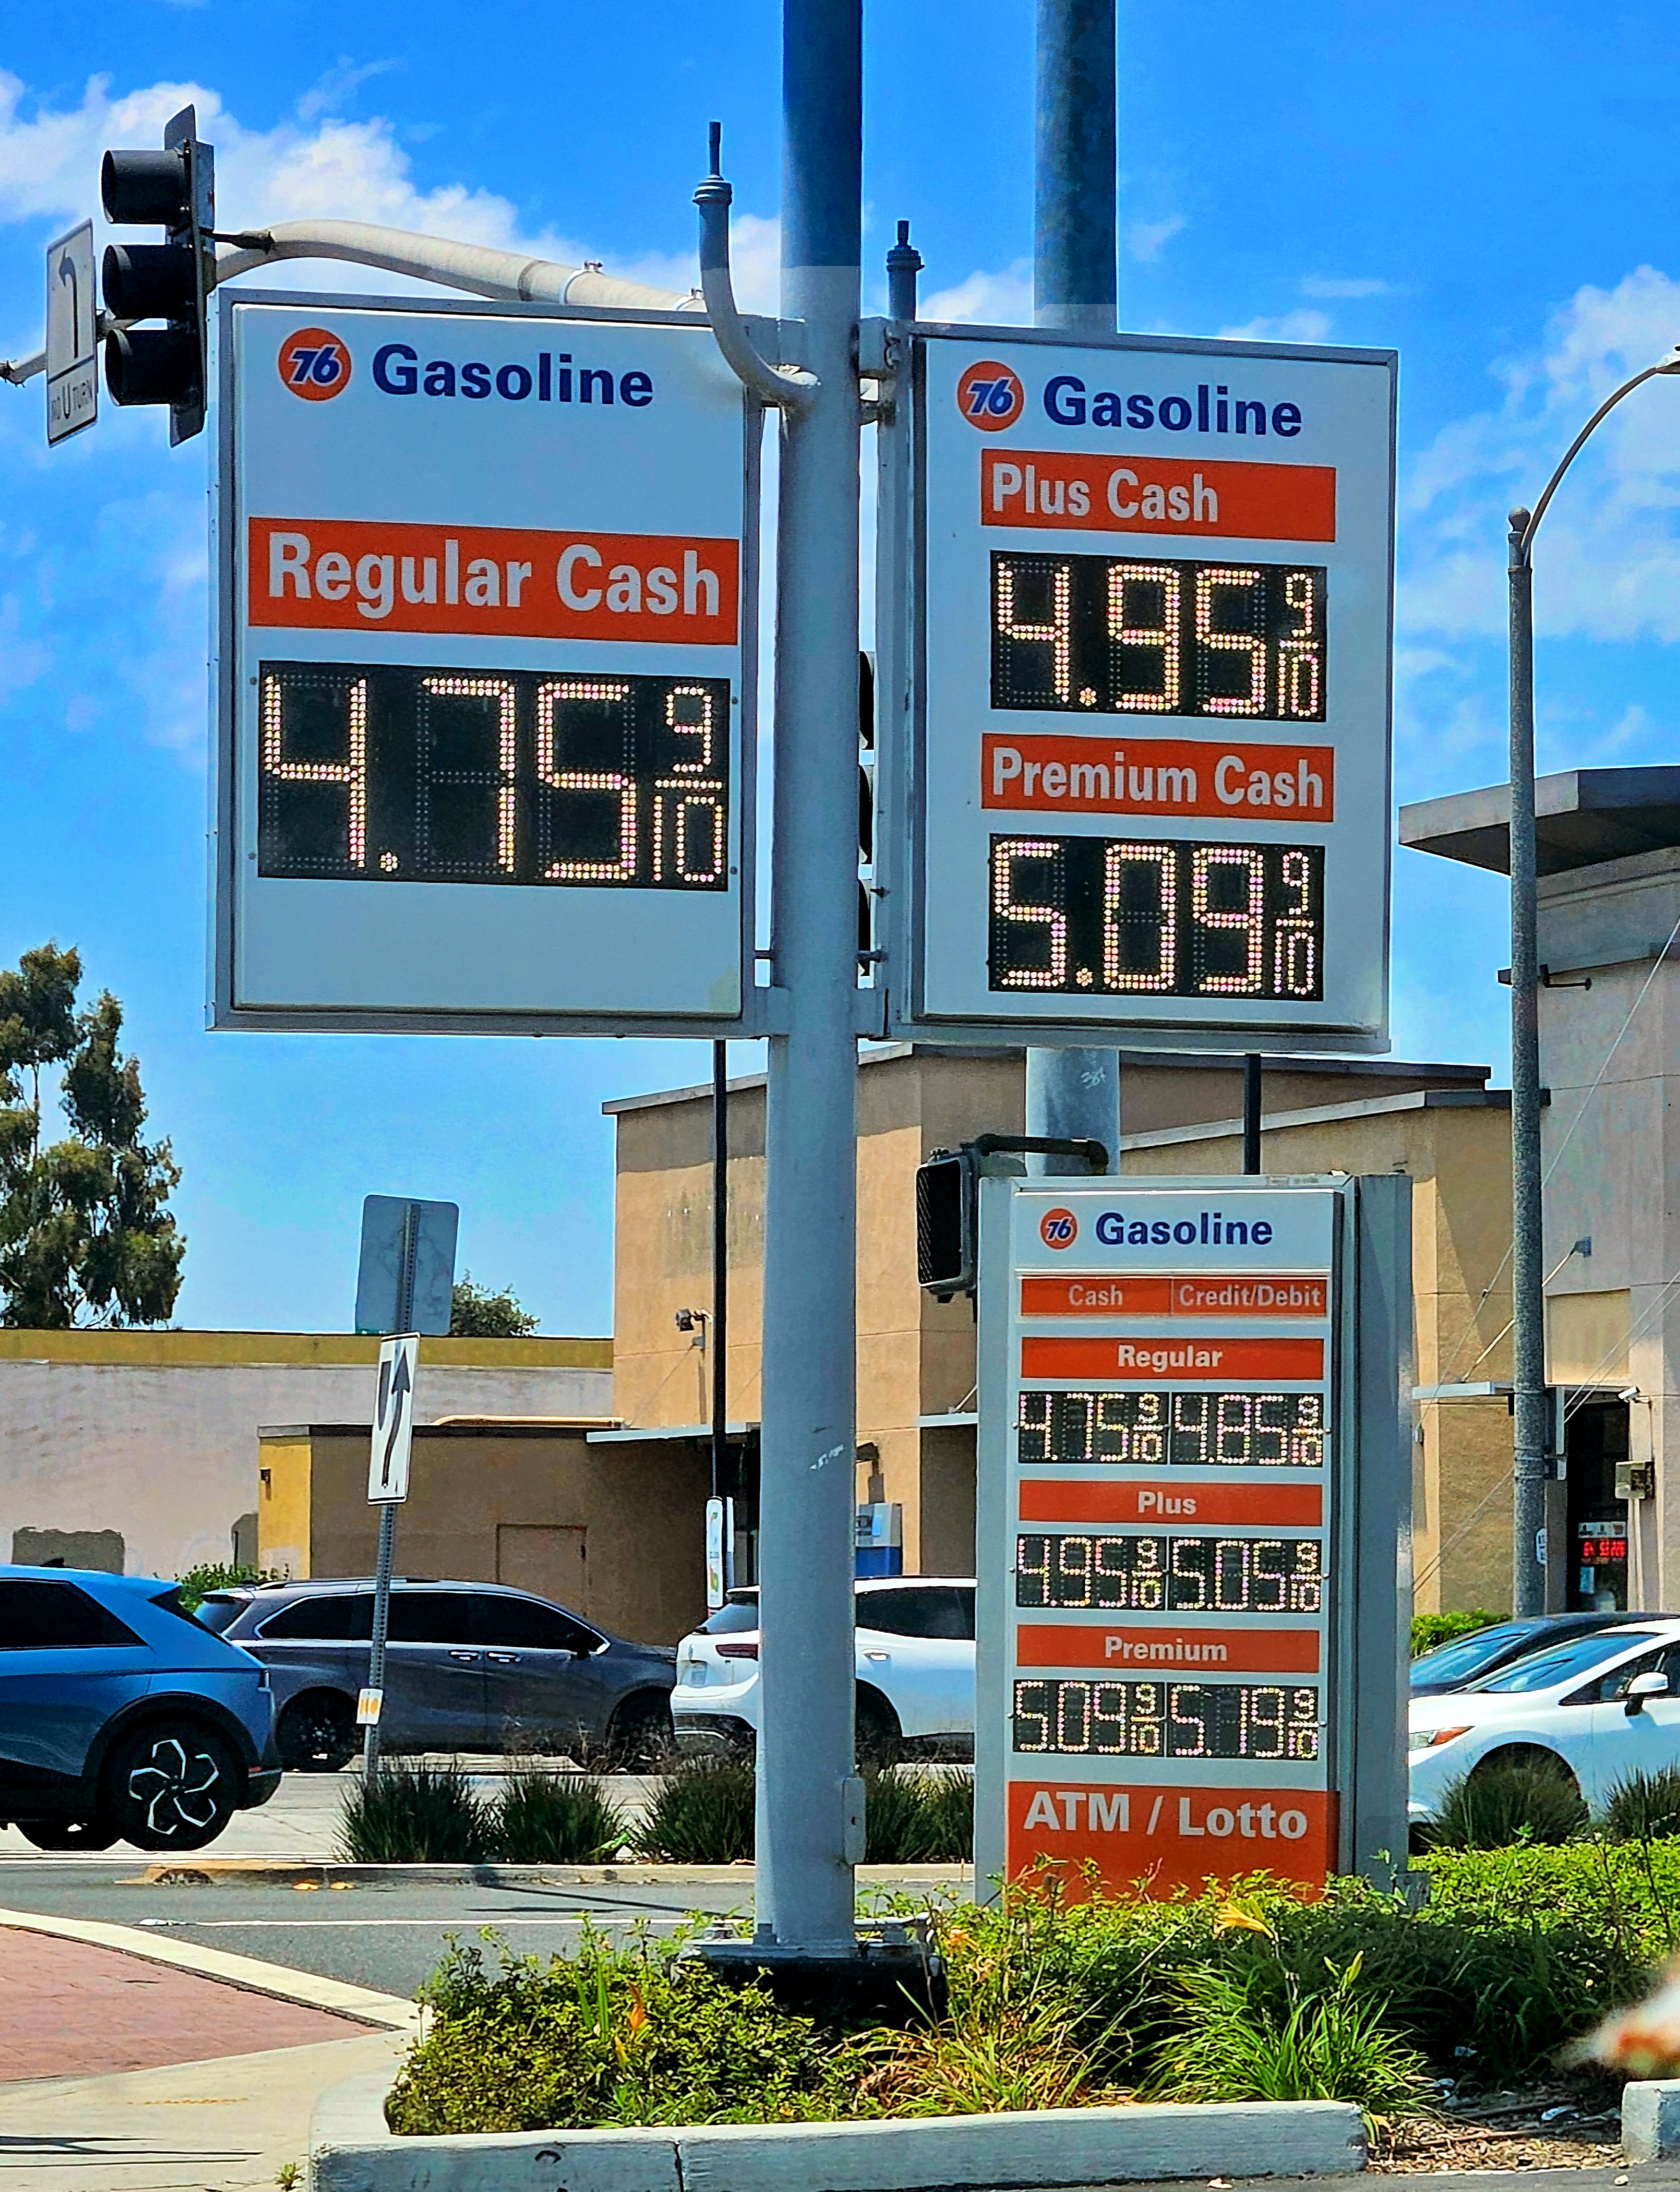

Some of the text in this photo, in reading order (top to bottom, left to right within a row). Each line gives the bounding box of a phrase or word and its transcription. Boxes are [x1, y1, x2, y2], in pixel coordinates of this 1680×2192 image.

[288, 344, 653, 407] 76 Gasoline
[967, 376, 1301, 437] 76 Gasoline
[992, 462, 1217, 522] Plus Cash
[269, 531, 719, 619] Regular Cash
[998, 561, 1267, 714] 4.95
[264, 675, 636, 879] 4.75
[992, 747, 1323, 807] Premium Cash
[994, 841, 1263, 992] 5.09
[1045, 1212, 1272, 1245] 76 Gasoline
[1068, 1285, 1123, 1306] Cash
[1179, 1284, 1321, 1306] Credit/Debit
[1118, 1345, 1223, 1373] Regular
[1138, 1491, 1197, 1515] Plus
[1105, 1636, 1227, 1661] Premium
[1023, 1791, 1308, 1839] ATM / Lotto
